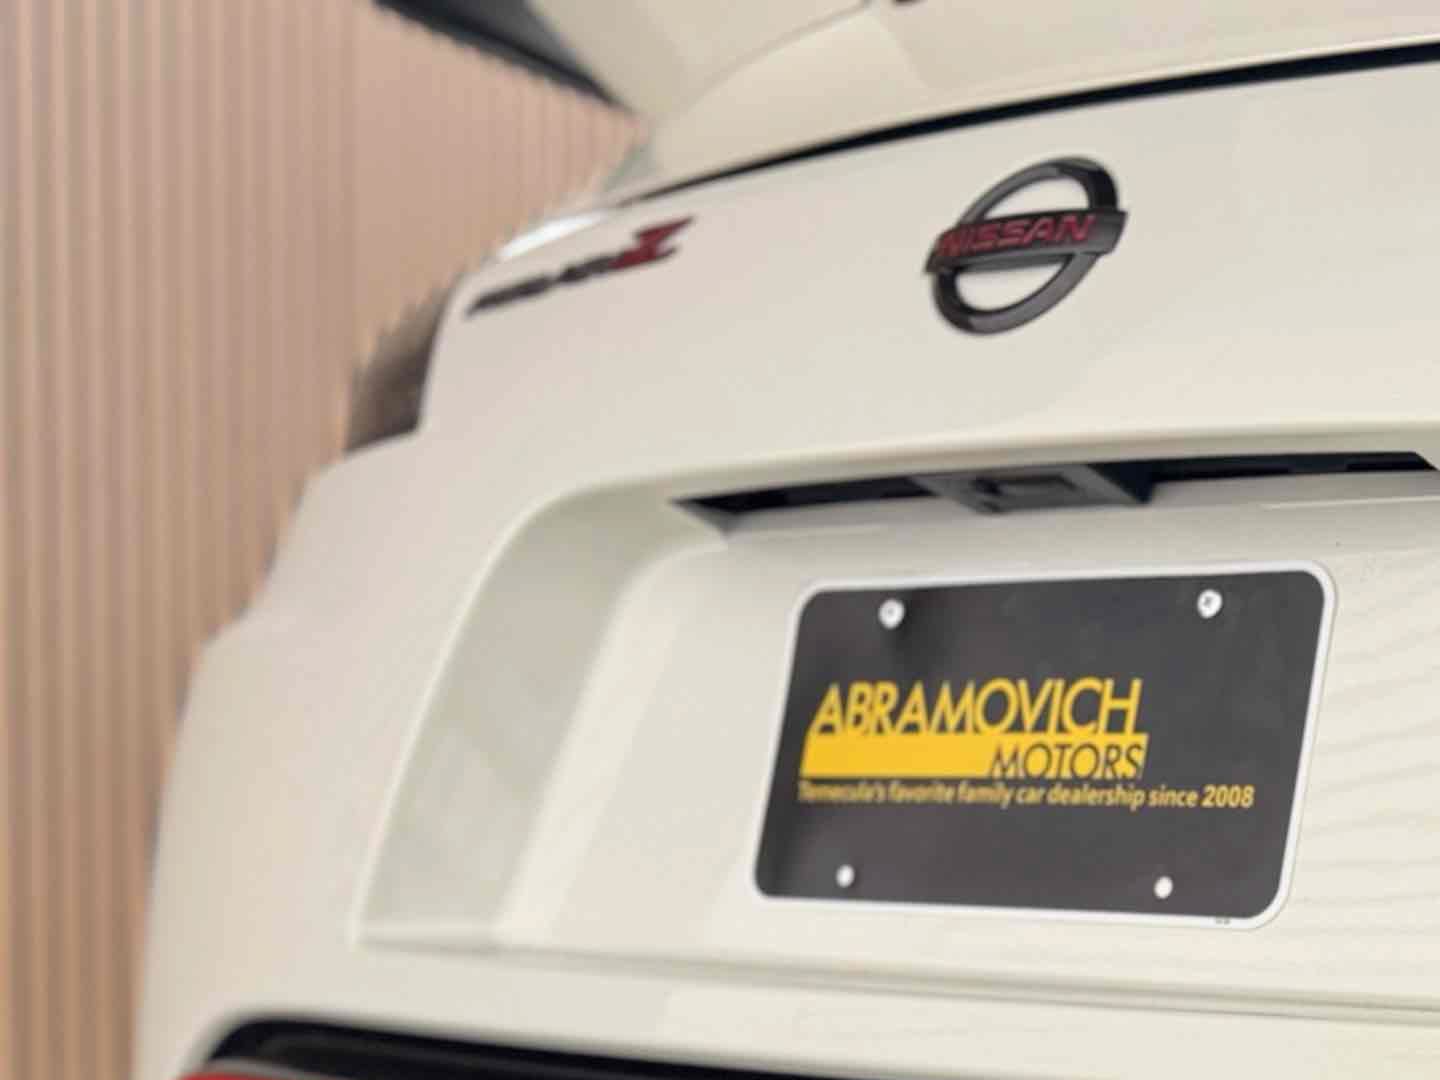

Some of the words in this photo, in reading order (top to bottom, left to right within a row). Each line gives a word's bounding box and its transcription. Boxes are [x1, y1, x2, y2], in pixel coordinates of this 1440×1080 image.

[937, 214, 1096, 257] NISSAN
[809, 676, 1143, 735] ABRAMOVICH
[988, 742, 1146, 779] MOTORS
[889, 779, 954, 804] favorite
[957, 780, 1012, 811] family
[1013, 785, 1045, 804] car
[1047, 783, 1144, 811] dealership
[1148, 784, 1198, 807] since
[1201, 785, 1255, 808] 2008
